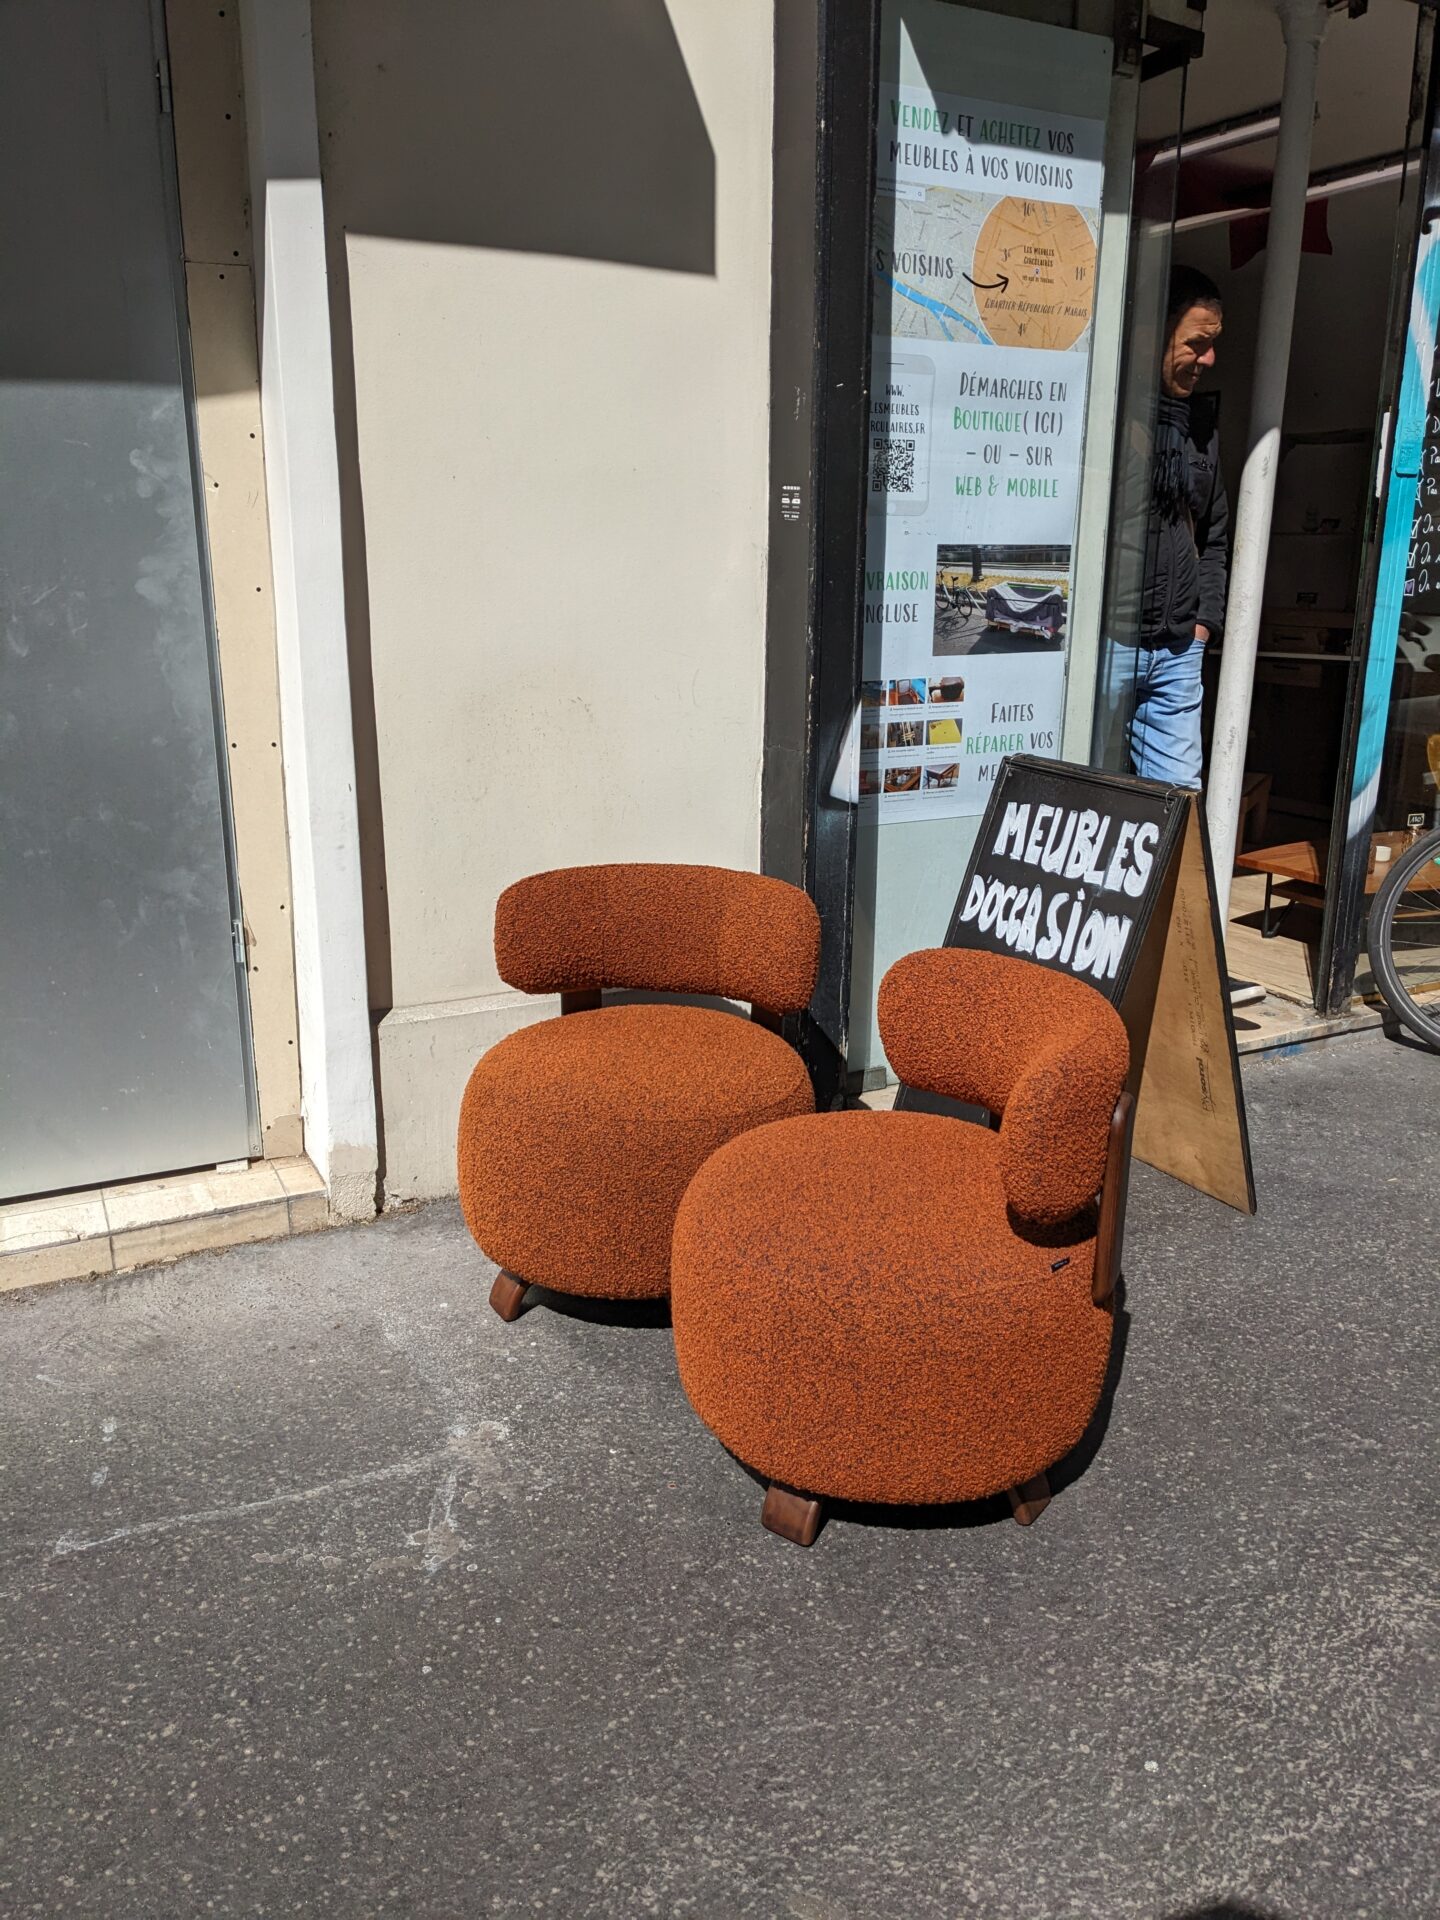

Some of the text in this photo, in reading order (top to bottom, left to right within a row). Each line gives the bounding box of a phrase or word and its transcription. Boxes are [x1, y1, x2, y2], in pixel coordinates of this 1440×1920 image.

[890, 99, 1075, 154] VENDEZ ET ACHETEZ VOS
[889, 140, 1074, 190] MEUBLES À VOS VOISINS
[891, 250, 954, 279] VOISINS
[959, 371, 1067, 402] DÉMARCHES EN
[870, 401, 920, 416] ESMEUBLES
[983, 443, 1001, 464] OU
[1026, 446, 1053, 466] SUR
[955, 475, 982, 497] WEB
[1006, 477, 1059, 498] MOBILE
[991, 702, 1034, 724] FAITES
[965, 731, 1054, 755] RÉPARER VOS
[991, 801, 1159, 897] MEUBLES
